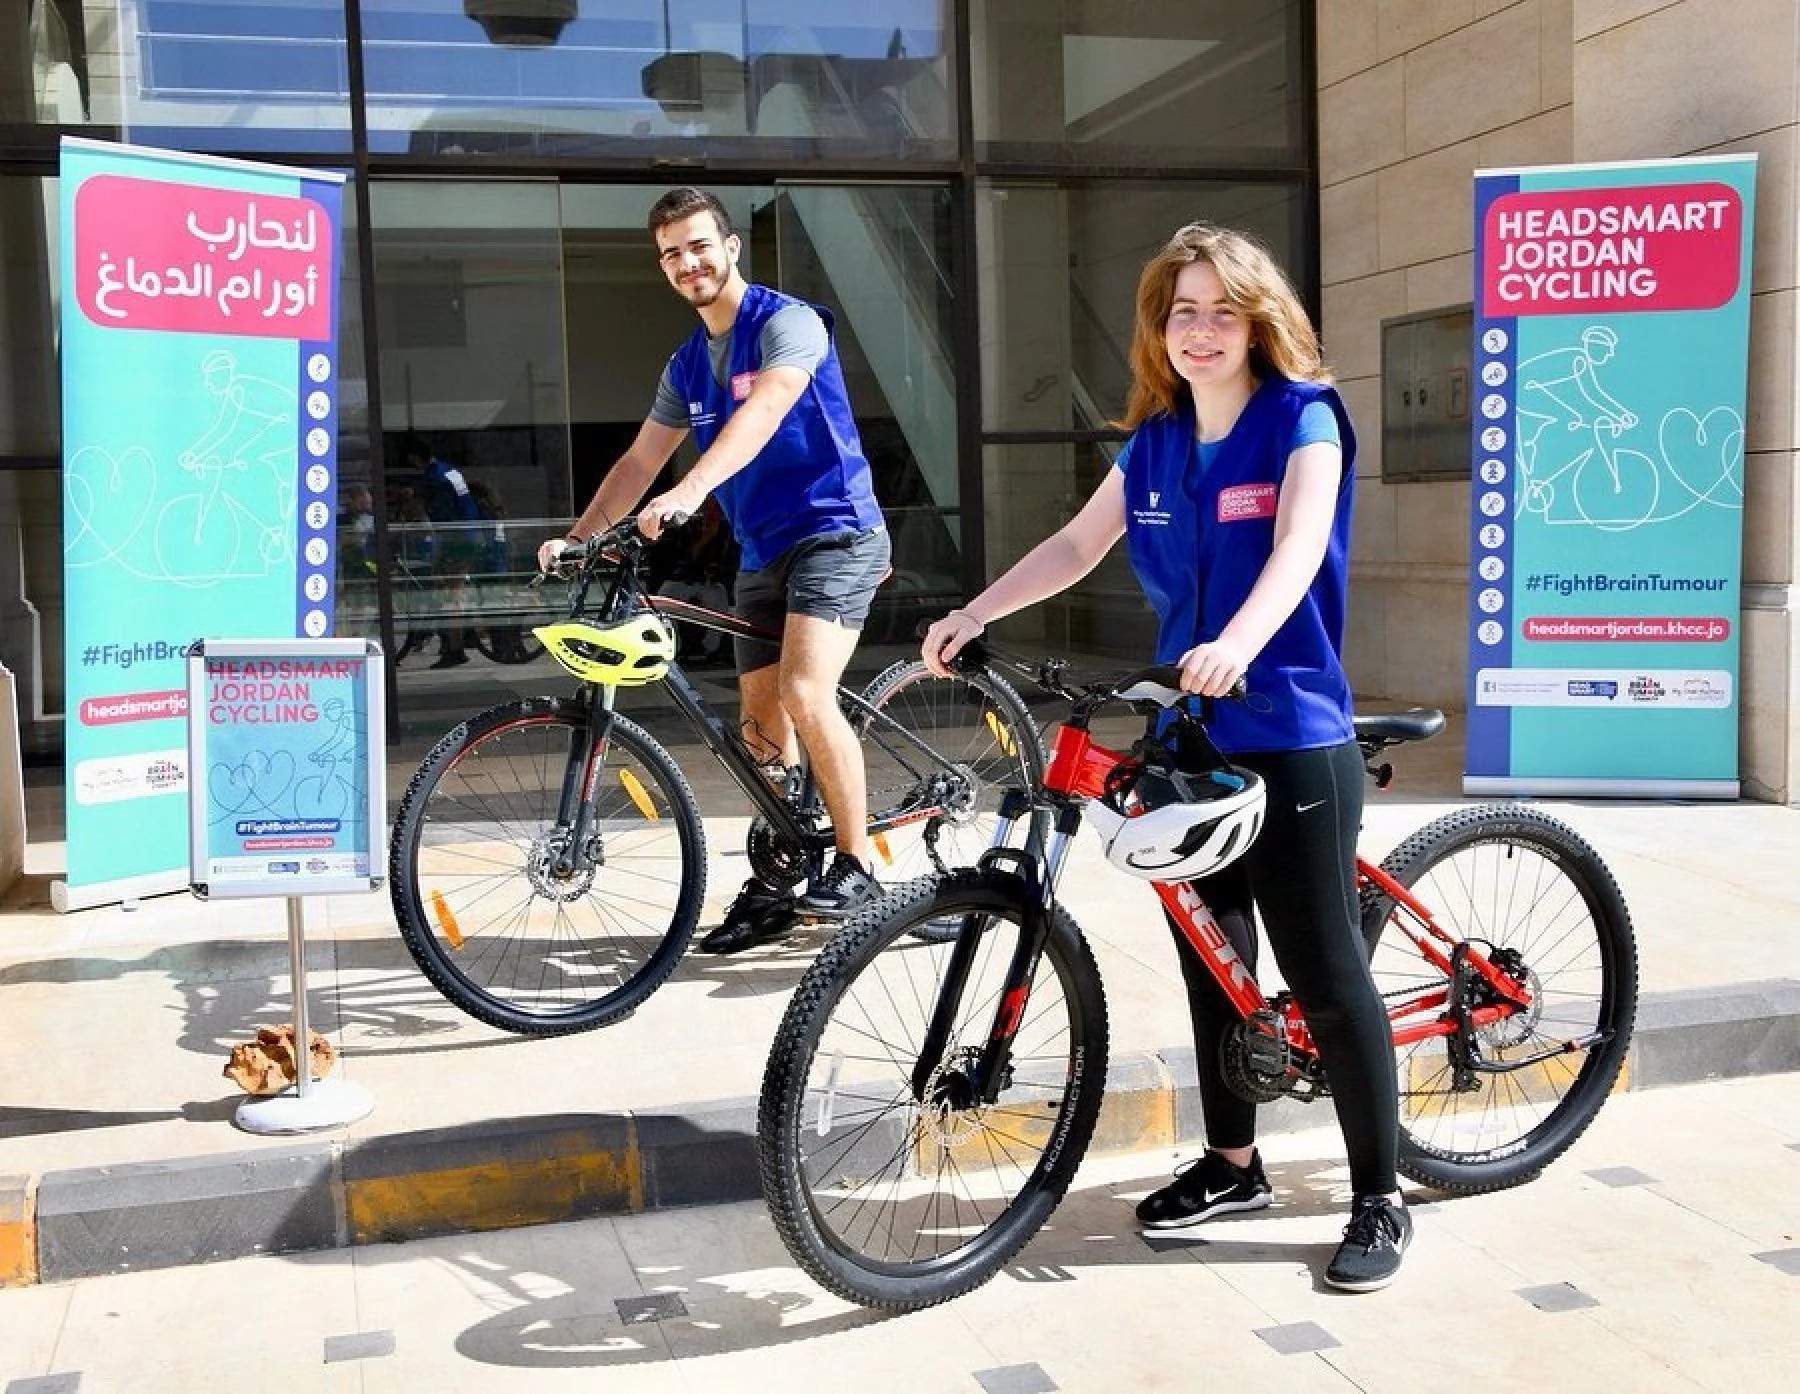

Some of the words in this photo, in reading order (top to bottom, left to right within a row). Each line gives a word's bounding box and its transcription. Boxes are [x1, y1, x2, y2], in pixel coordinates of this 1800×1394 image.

[186, 202, 317, 261] لنحارب
[1498, 200, 1730, 240] HEADSMART
[1498, 236, 1645, 271] JORDAN
[95, 251, 213, 318] الدماغ
[217, 264, 318, 318] أورام
[1498, 268, 1657, 301] CYCLING
[1525, 573, 1728, 596] #FightBrainTumour
[1529, 621, 1723, 638] headsmartjordan.khcc.jo
[208, 660, 363, 681] HEADSMART
[87, 694, 187, 719] headsmartjo
[209, 682, 310, 703] JORDAN
[209, 703, 320, 724] CYCLING
[1166, 880, 1259, 992] REK
